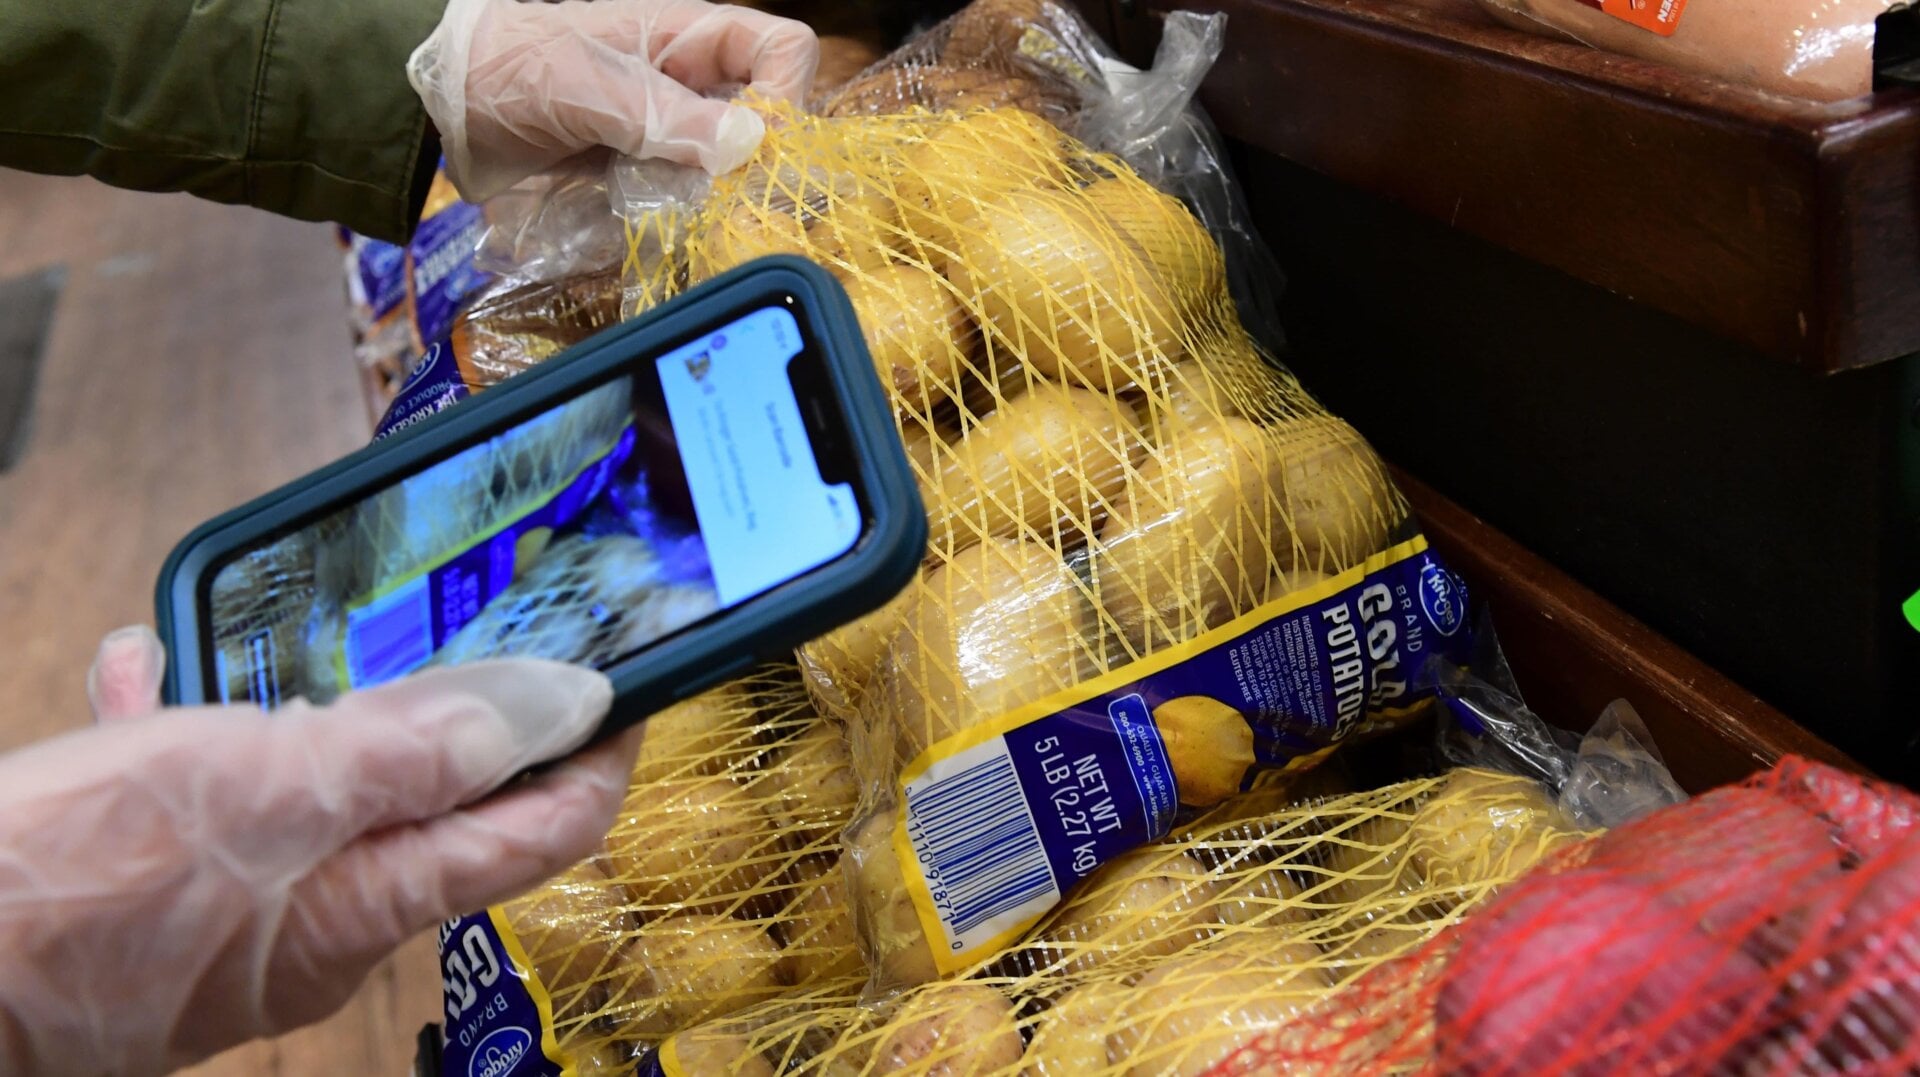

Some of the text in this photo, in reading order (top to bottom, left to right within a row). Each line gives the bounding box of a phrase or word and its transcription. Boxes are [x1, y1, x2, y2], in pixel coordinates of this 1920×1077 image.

[1657, 0, 1674, 23] EN
[1396, 585, 1422, 652] BRAND
[1427, 574, 1455, 625] Kroger
[1250, 639, 1259, 656] FOR
[1255, 657, 1263, 668] UP
[1257, 636, 1268, 662] STORE
[1265, 662, 1272, 672] IN
[1264, 631, 1276, 659] MEETS
[1273, 659, 1280, 671] OR
[1277, 672, 1291, 708] EXCEEDS
[1272, 626, 1286, 664] PRODUCE
[1283, 665, 1289, 674] OF
[1282, 623, 1297, 670] CINCINNATI,
[1293, 670, 1302, 689] OHIO
[1292, 619, 1306, 669] DISTRIBUTED
[1302, 615, 1318, 669] INGREDIENTS:
[1312, 670, 1322, 691] GOLD
[1358, 583, 1406, 704] GOLD
[1230, 649, 1252, 702] GLUTEN FREE
[1240, 644, 1252, 668] WASH
[1246, 669, 1262, 700] BEFORE
[1258, 669, 1266, 680] TO
[1301, 671, 1309, 681] BY
[1304, 683, 1312, 698] THE
[1322, 602, 1363, 741] POTATOES
[1119, 711, 1144, 766] 800-632-6900
[1137, 725, 1155, 761] QUALITY
[1035, 736, 1104, 877] 5 LB (2.27 kg)
[1073, 754, 1121, 833] NET WT
[926, 868, 955, 921] 91871
[952, 941, 963, 949] 0
[459, 992, 509, 1047] BRAND
